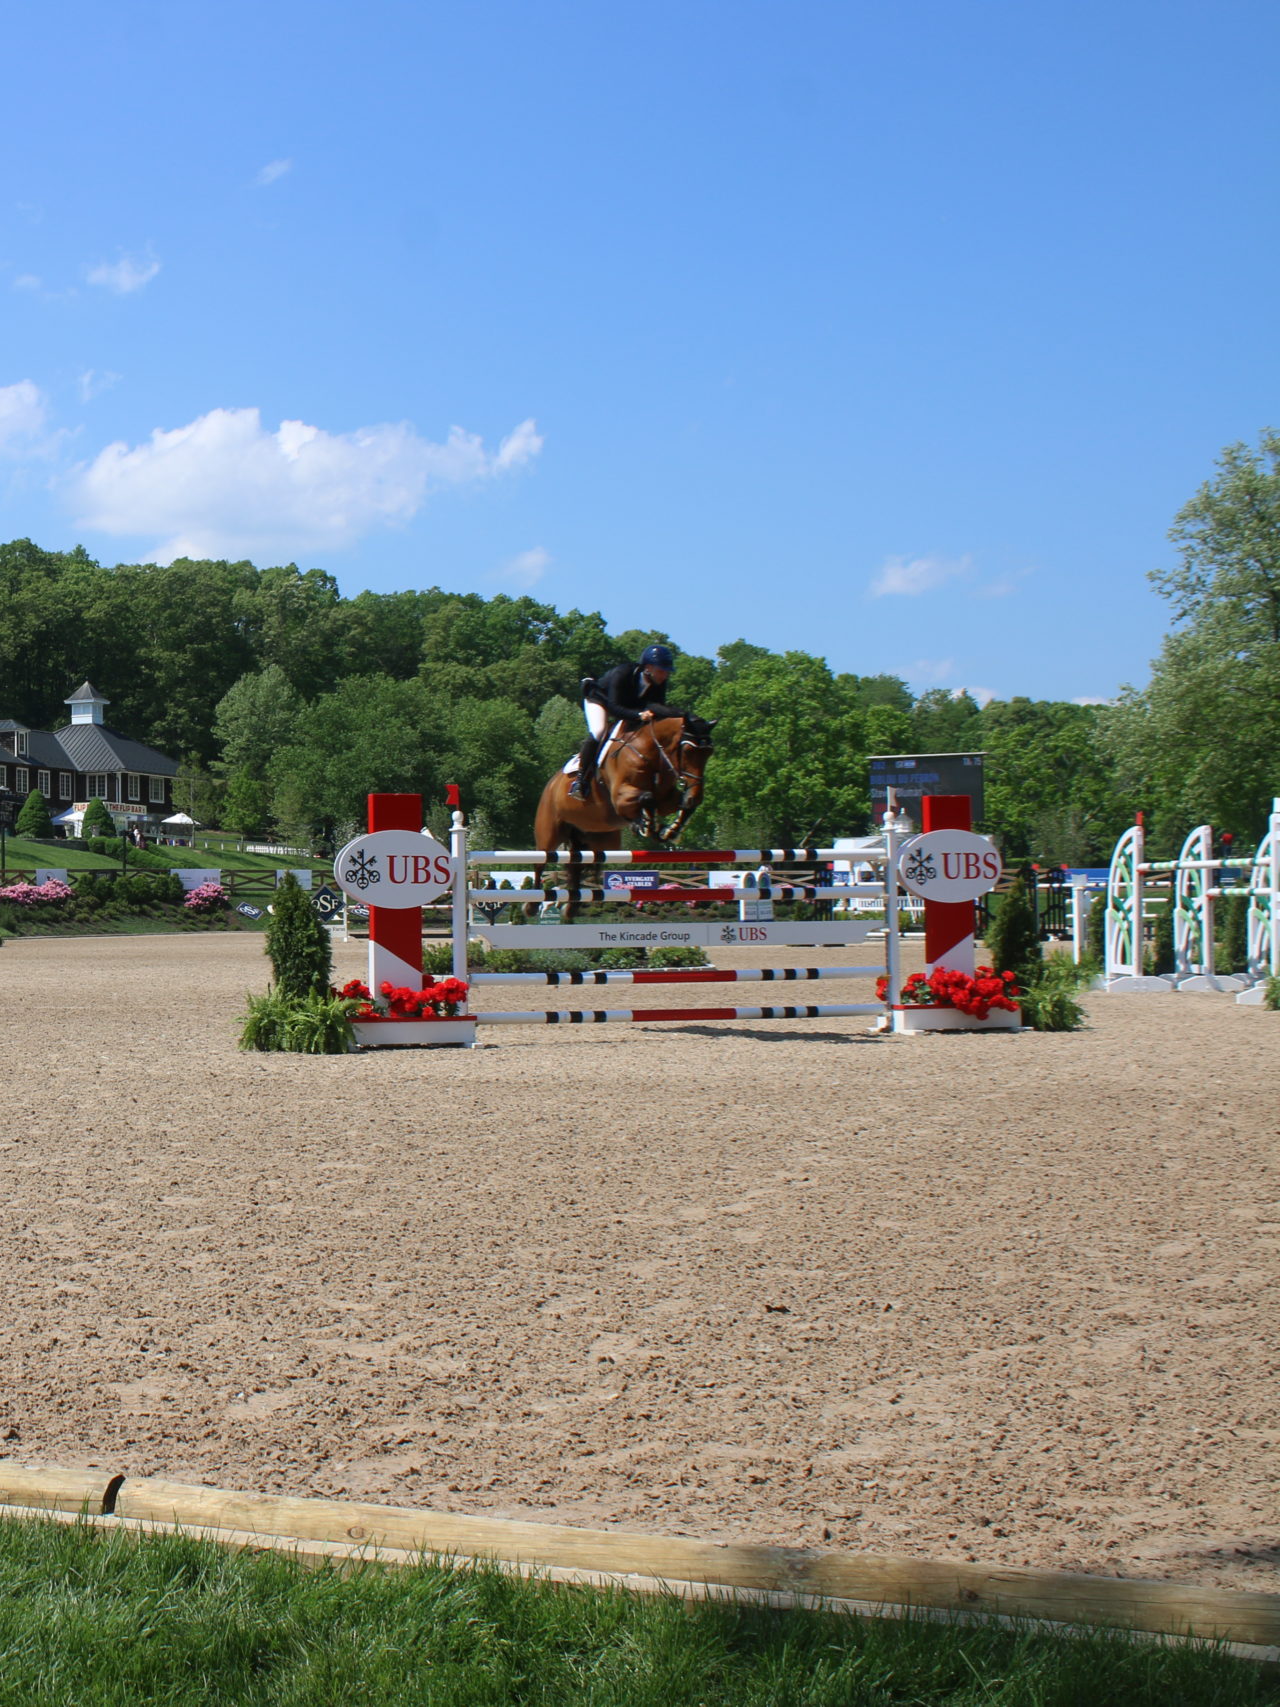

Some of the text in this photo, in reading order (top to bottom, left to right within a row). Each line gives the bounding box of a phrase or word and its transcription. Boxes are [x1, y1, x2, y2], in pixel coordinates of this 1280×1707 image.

[386, 855, 451, 885] UBS
[941, 852, 998, 880] UBS
[599, 931, 691, 943] The Kincade Group
[738, 927, 768, 941] UBS
